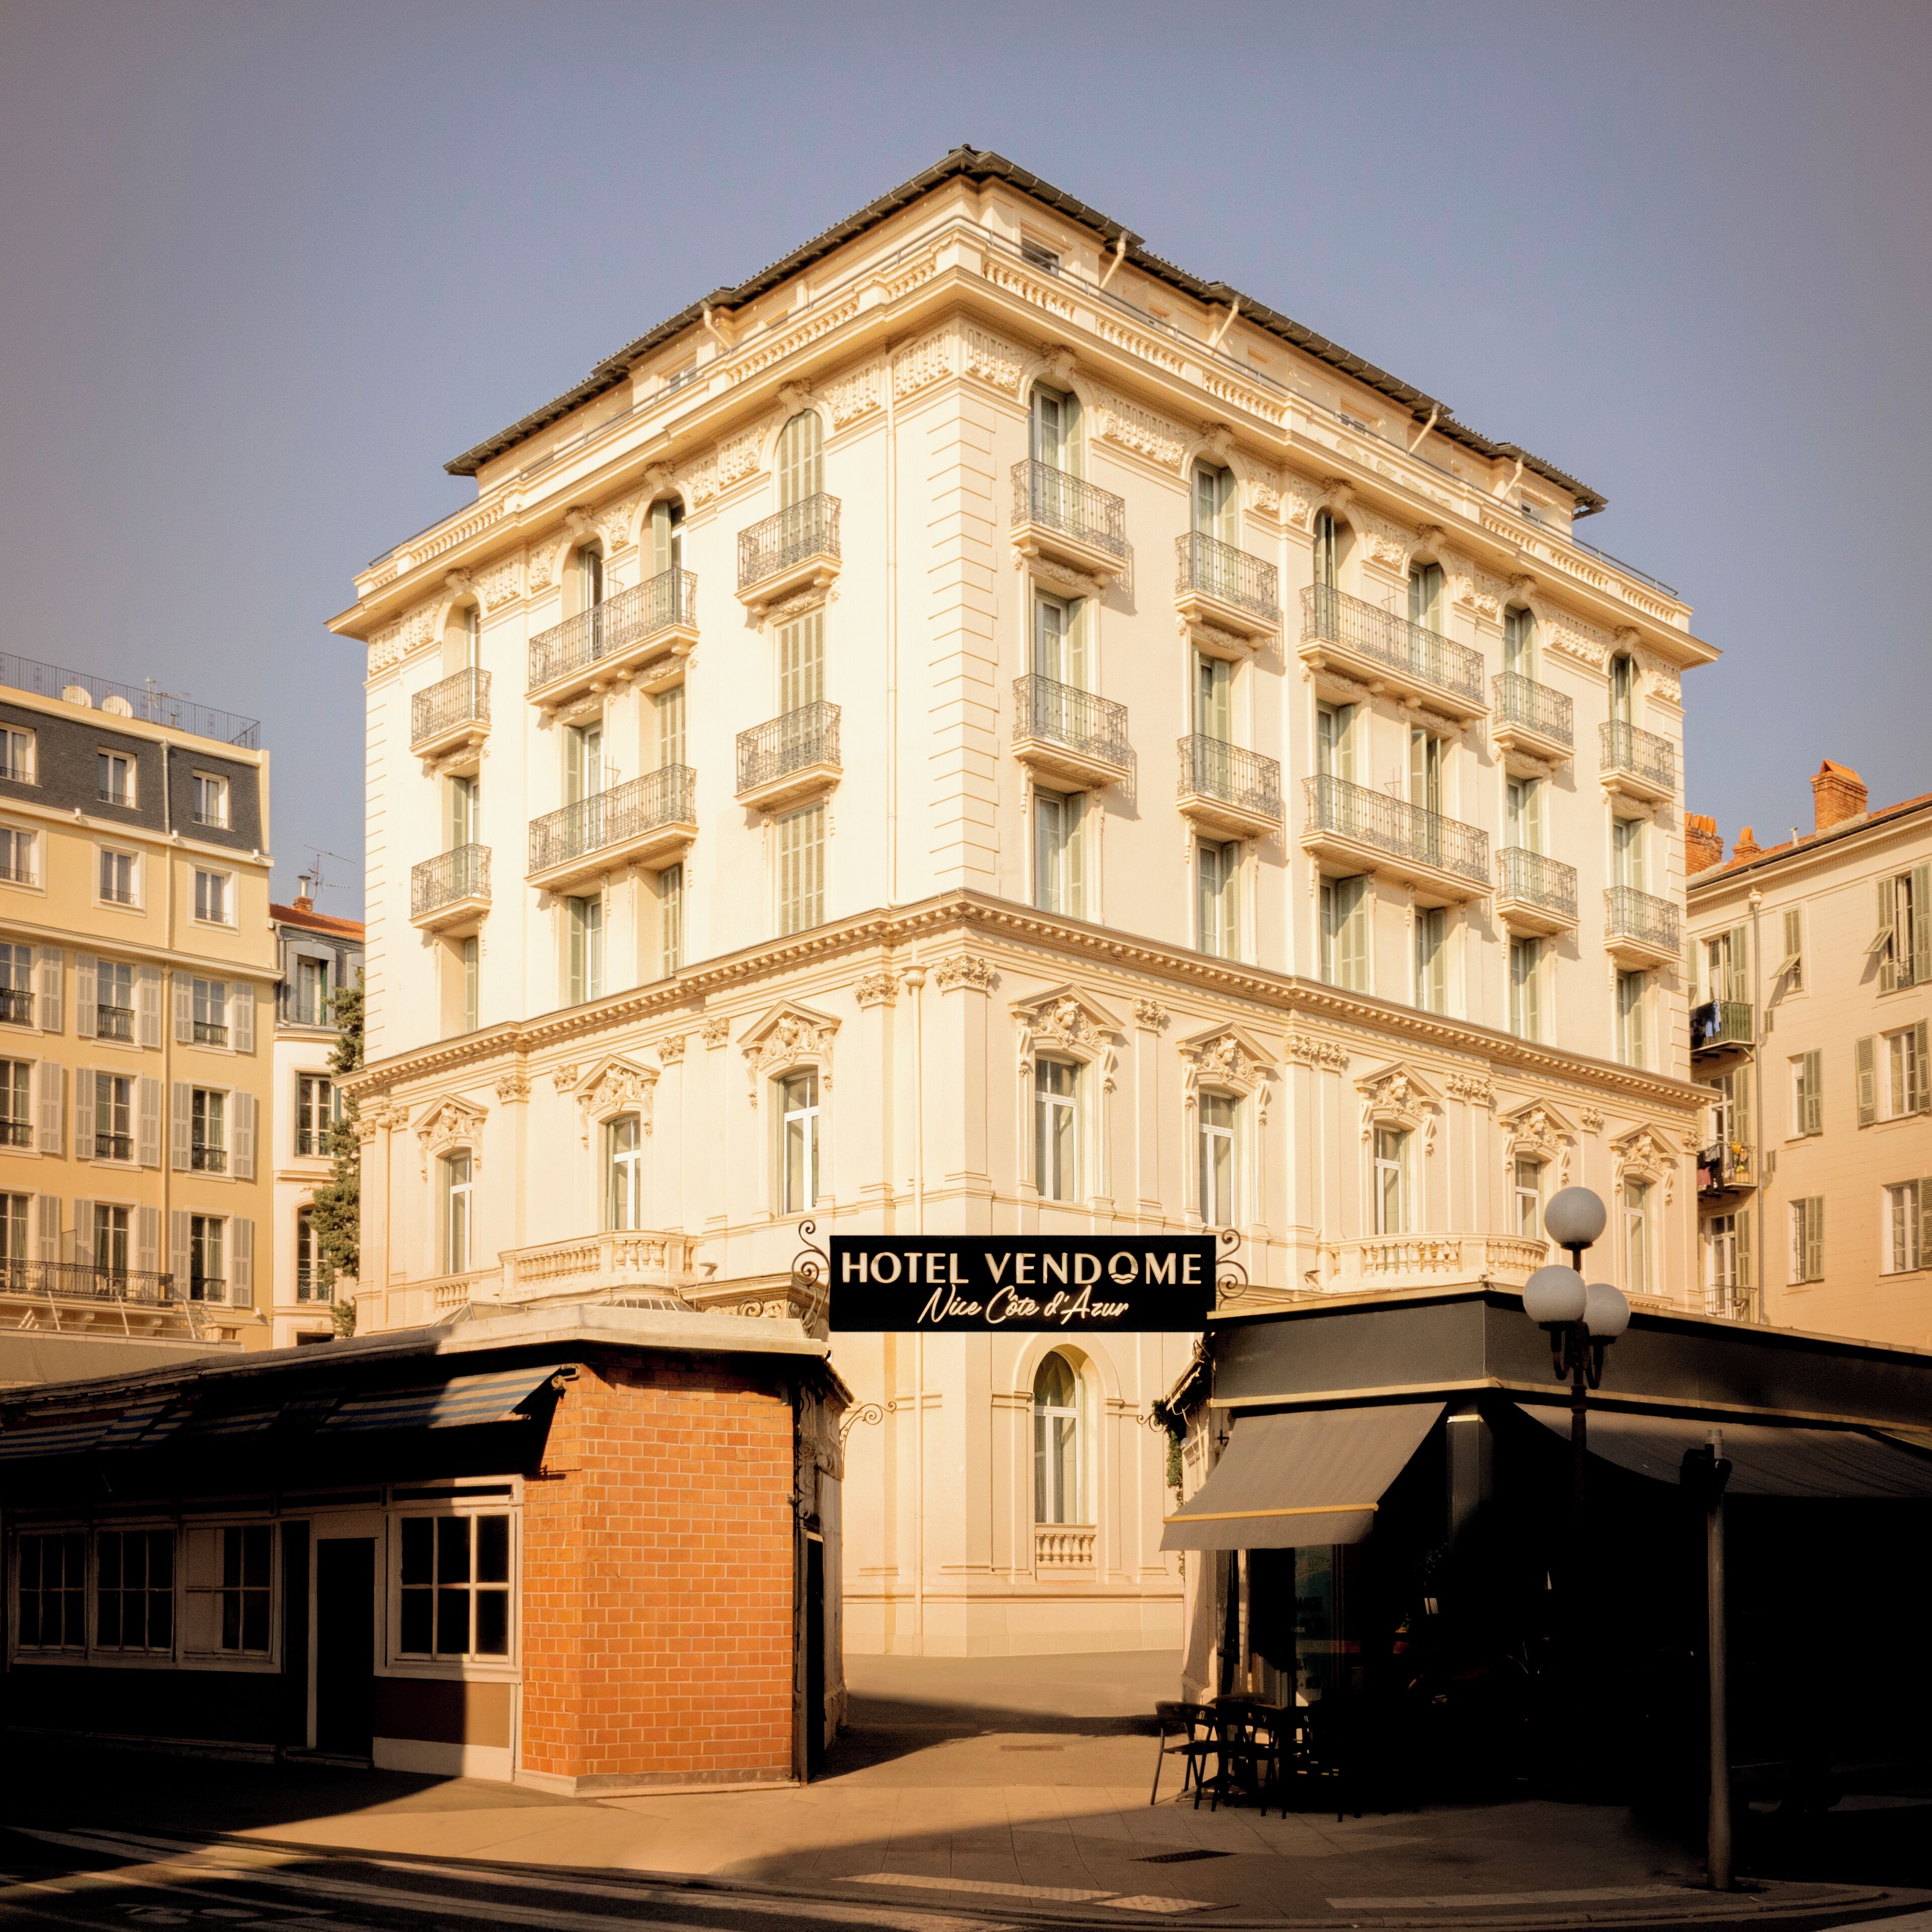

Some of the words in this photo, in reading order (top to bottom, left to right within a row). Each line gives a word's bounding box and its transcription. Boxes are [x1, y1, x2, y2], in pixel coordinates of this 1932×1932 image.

[842, 1252, 969, 1284] HOTEL
[985, 1251, 1201, 1284] VENDOME
[917, 1283, 983, 1323] Nice
[985, 1284, 1040, 1324] Côte
[1043, 1284, 1129, 1325] d'Azur
